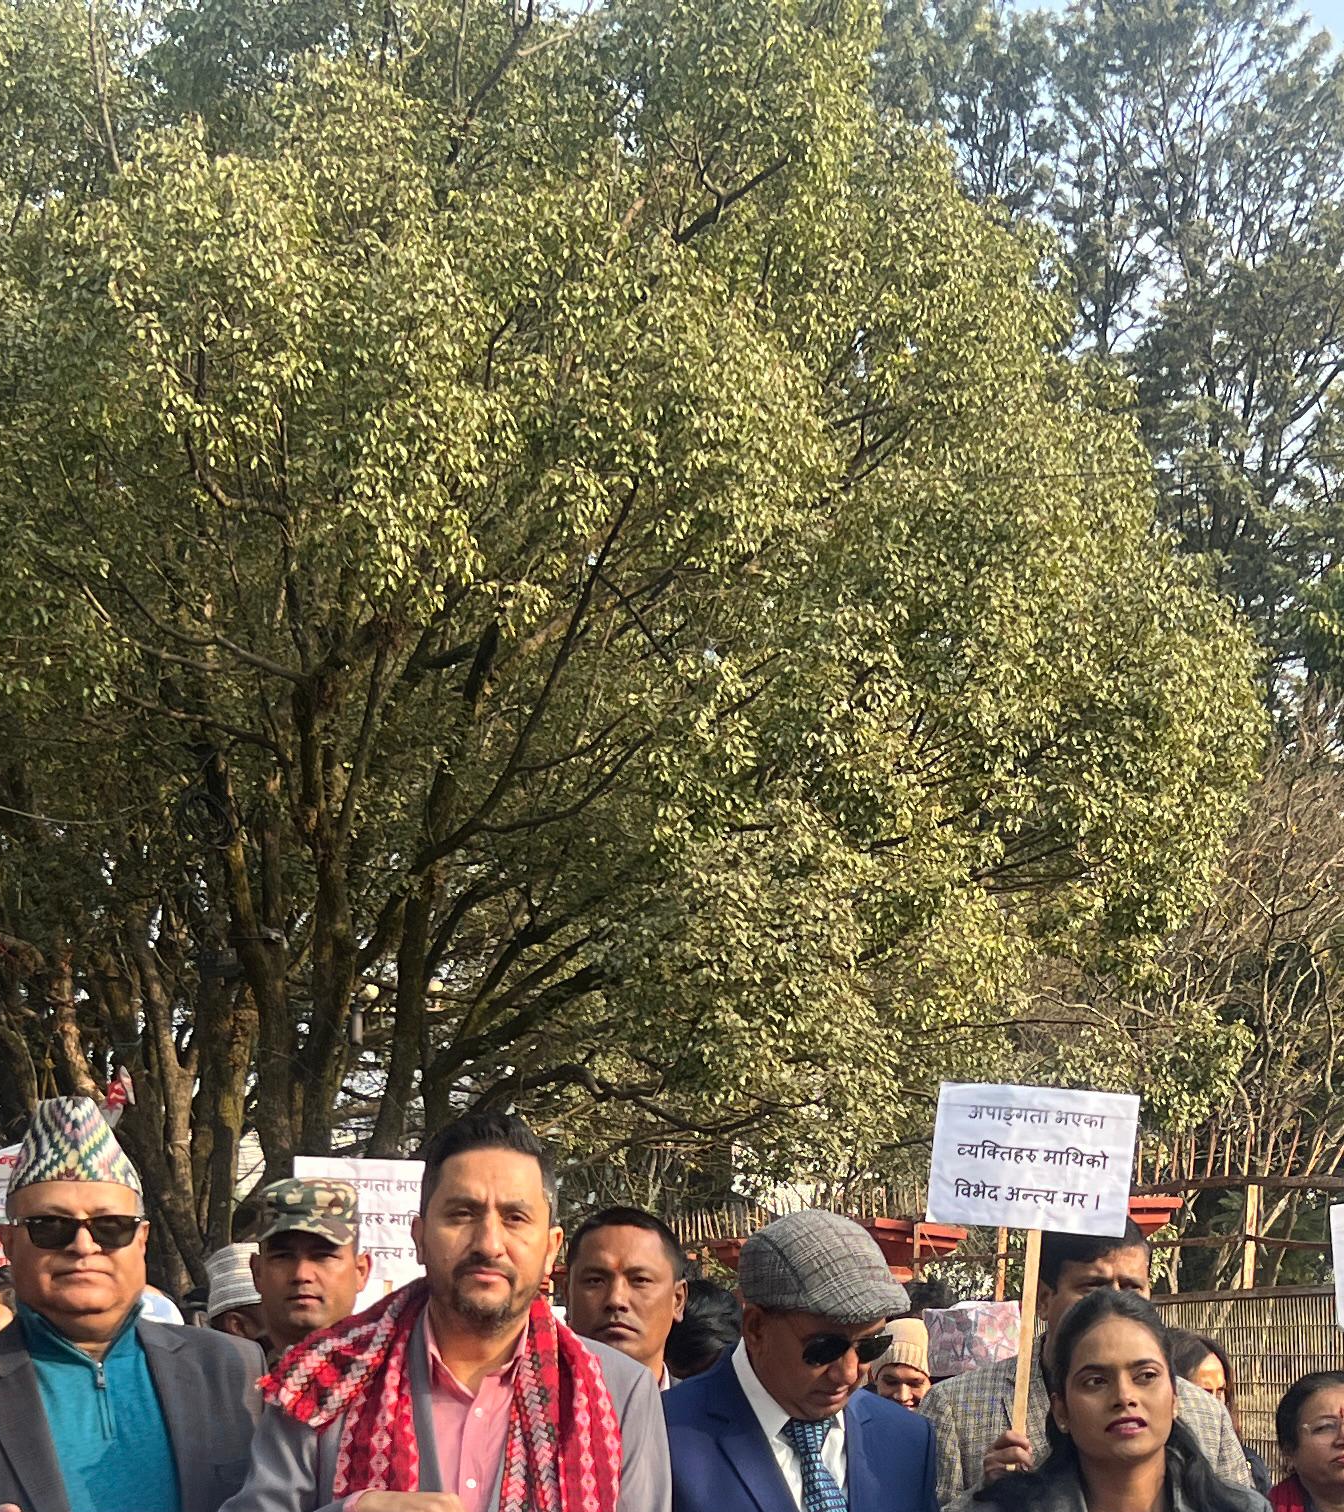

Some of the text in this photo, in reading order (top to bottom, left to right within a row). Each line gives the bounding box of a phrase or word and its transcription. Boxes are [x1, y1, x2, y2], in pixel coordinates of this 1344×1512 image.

[1056, 1110, 1105, 1129] भएका
[1043, 1147, 1109, 1170] माथिको
[955, 1178, 1000, 1201] विभेद
[1063, 1192, 1088, 1208] गर
